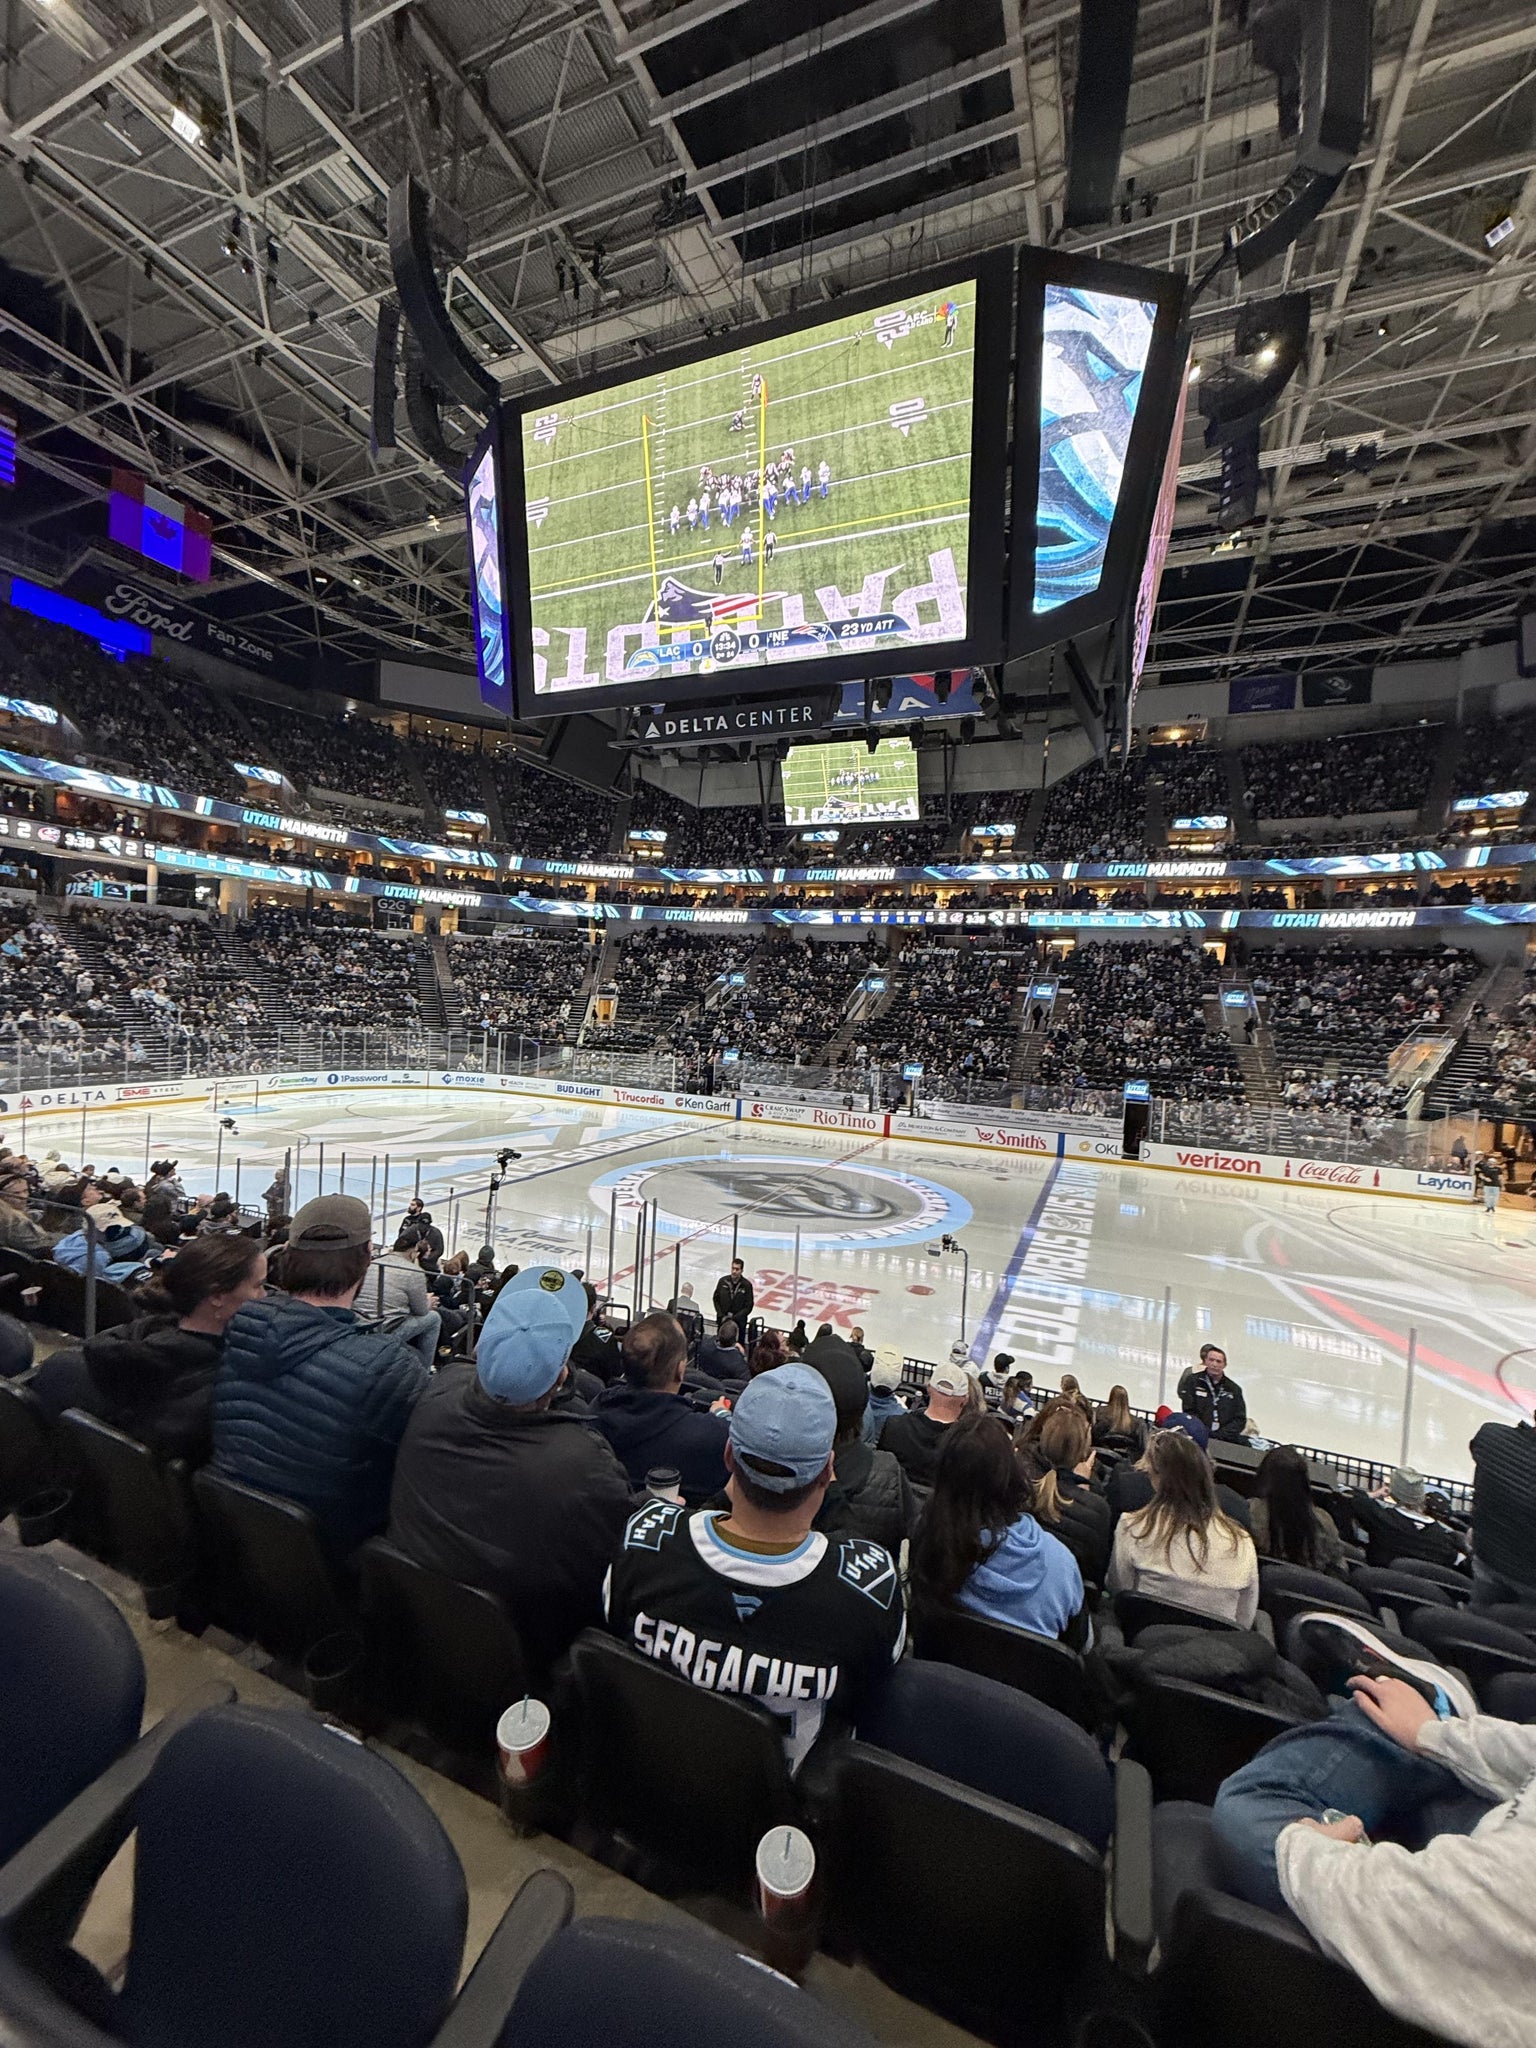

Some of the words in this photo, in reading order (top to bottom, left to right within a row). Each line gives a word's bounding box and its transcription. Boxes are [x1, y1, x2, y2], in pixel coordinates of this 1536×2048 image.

[105, 584, 195, 642] Ford
[840, 622, 860, 637] 23
[860, 621, 874, 634] YD
[874, 618, 895, 633] ATT
[207, 623, 236, 646] Fan
[238, 636, 274, 662] Zone
[714, 640, 737, 652] 13:34
[748, 633, 760, 648] 0
[659, 645, 681, 659] LAC
[692, 642, 703, 656] 0
[664, 715, 728, 736] DELTA
[735, 706, 813, 728] CENTER
[17, 820, 32, 839] 2
[242, 809, 280, 830] UTAH
[280, 817, 349, 845] MAMMOTH
[124, 841, 138, 857] 2
[546, 861, 577, 875] UTAH
[576, 863, 635, 880] MAMMOTH
[806, 869, 835, 882] UTAH
[835, 867, 896, 882] MAMMOTH
[1107, 863, 1148, 878] UTAH
[1148, 861, 1228, 878] MAMMOTH
[377, 898, 406, 912] G2G
[384, 885, 418, 900] UTAH
[418, 889, 482, 908] MAMMOTH
[664, 909, 694, 922] UTAH
[693, 909, 749, 924] MAMMOTH
[1272, 912, 1321, 929] UTAH
[1318, 911, 1417, 928] MAMMOTH
[341, 1074, 388, 1083] 1Password
[455, 1075, 486, 1084] moxie
[40, 1089, 107, 1106] DELTA
[121, 1087, 151, 1098] SME
[556, 1084, 575, 1094] BUD
[575, 1086, 601, 1097] LIGHT
[620, 1090, 665, 1106] Trucordia
[684, 1097, 704, 1111] Ken
[705, 1099, 731, 1113] Garff
[764, 1104, 785, 1112] CRAIG
[785, 1105, 806, 1115] SWAPP
[812, 1109, 838, 1124] Rio
[837, 1111, 877, 1130] Tinto
[996, 1129, 1047, 1150] Smith's
[1176, 1151, 1262, 1175] verizon
[1299, 1161, 1362, 1185] Coca-Cola
[1417, 1173, 1472, 1192] Layton
[613, 1172, 650, 1200] DELTA
[911, 1183, 950, 1213] DELTA
[835, 1215, 943, 1241] CENTER
[518, 1240, 584, 1256] FIRST
[753, 1286, 869, 1329] EEK
[632, 1505, 678, 1542] UTAH
[845, 1545, 887, 1582] UTAH
[632, 1611, 840, 1701] SERGACHEV
